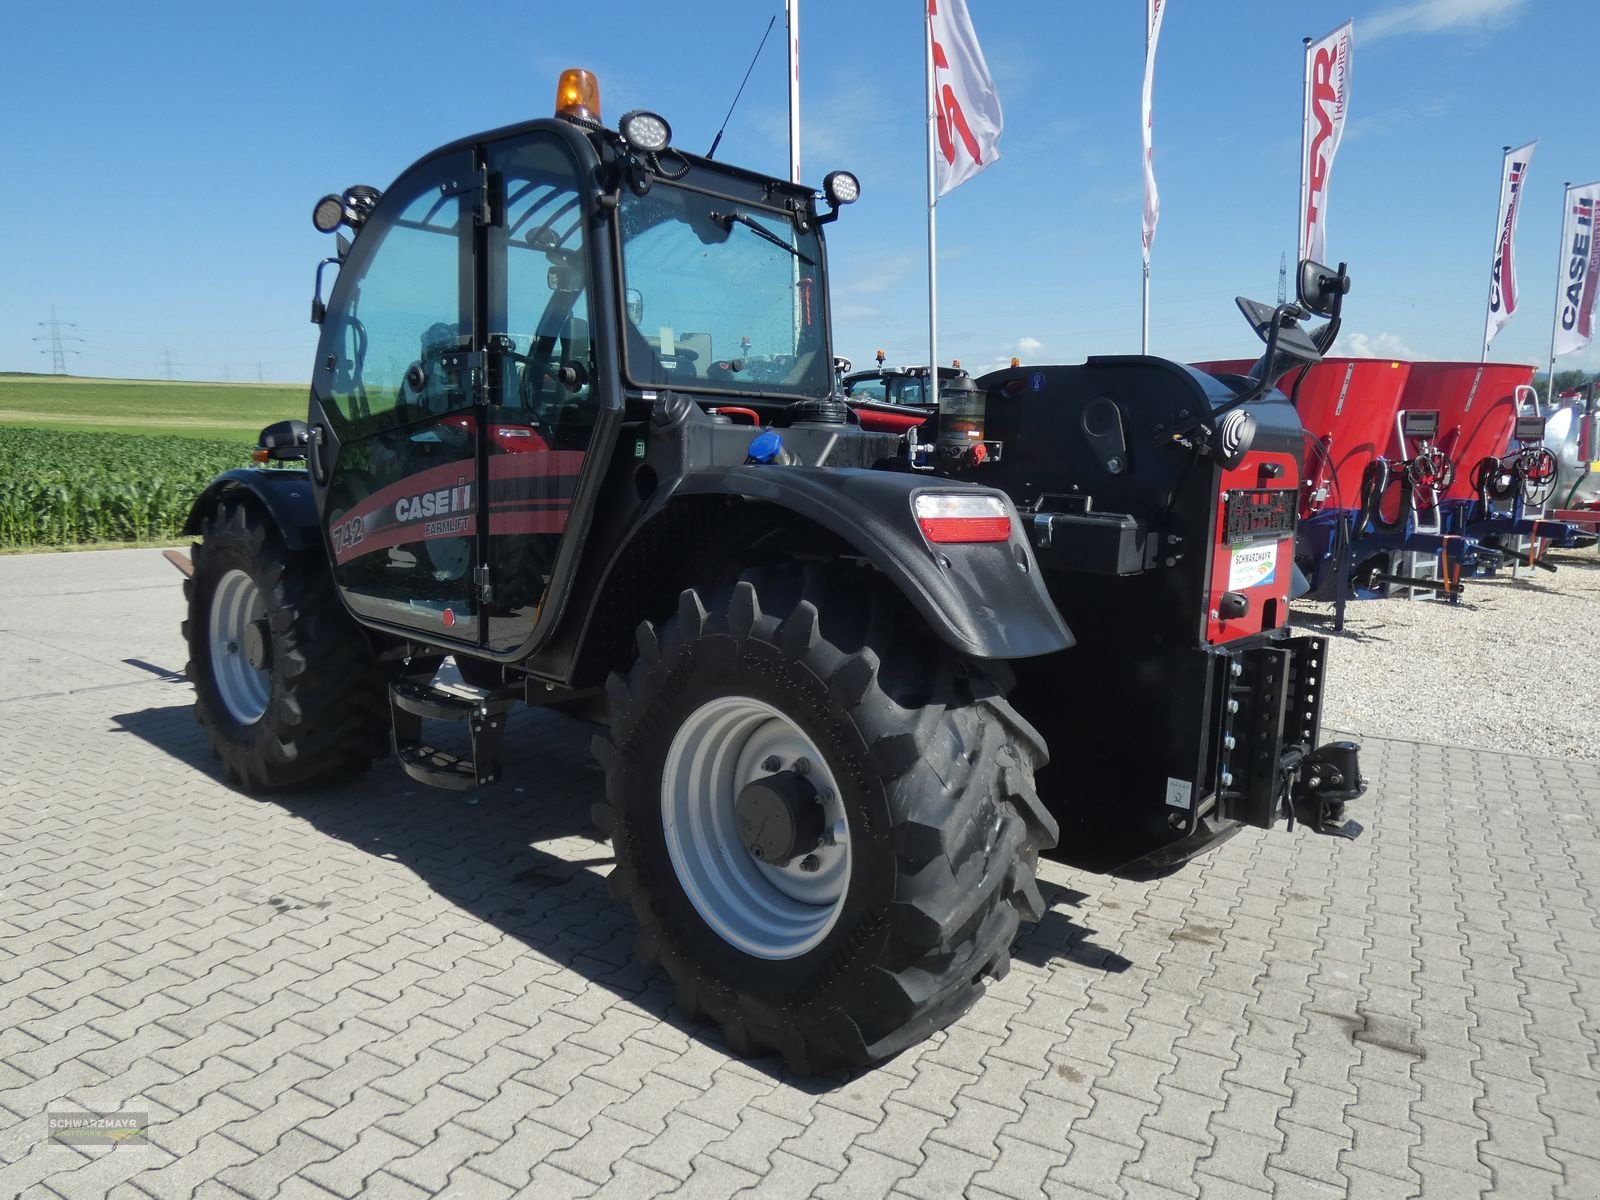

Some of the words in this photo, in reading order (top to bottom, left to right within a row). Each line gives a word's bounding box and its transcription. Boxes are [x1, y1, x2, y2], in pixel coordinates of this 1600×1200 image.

[1562, 233, 1591, 331] CASE
[395, 490, 449, 522] CASE
[333, 516, 364, 554] 742
[424, 515, 470, 537] FARMLIFT
[1235, 551, 1271, 565] SCHWARZMAYR
